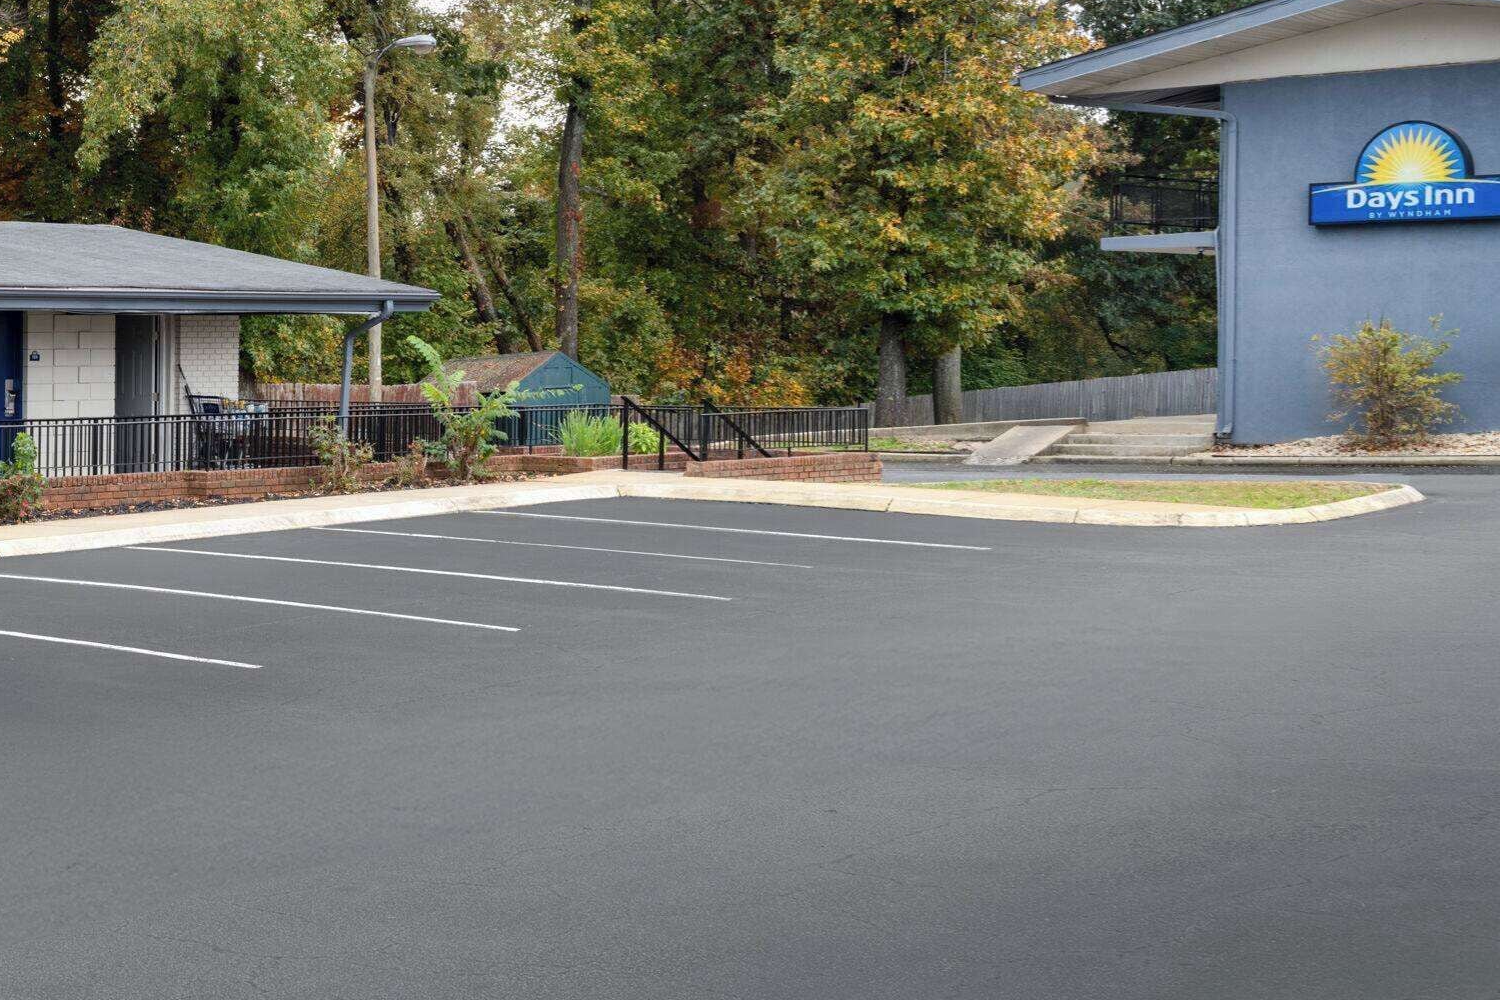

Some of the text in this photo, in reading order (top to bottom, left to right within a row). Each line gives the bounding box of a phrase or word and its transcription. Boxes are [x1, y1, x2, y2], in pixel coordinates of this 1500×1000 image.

[1347, 186, 1475, 209] Days Inn
[1388, 209, 1452, 218] WYNDHAM
